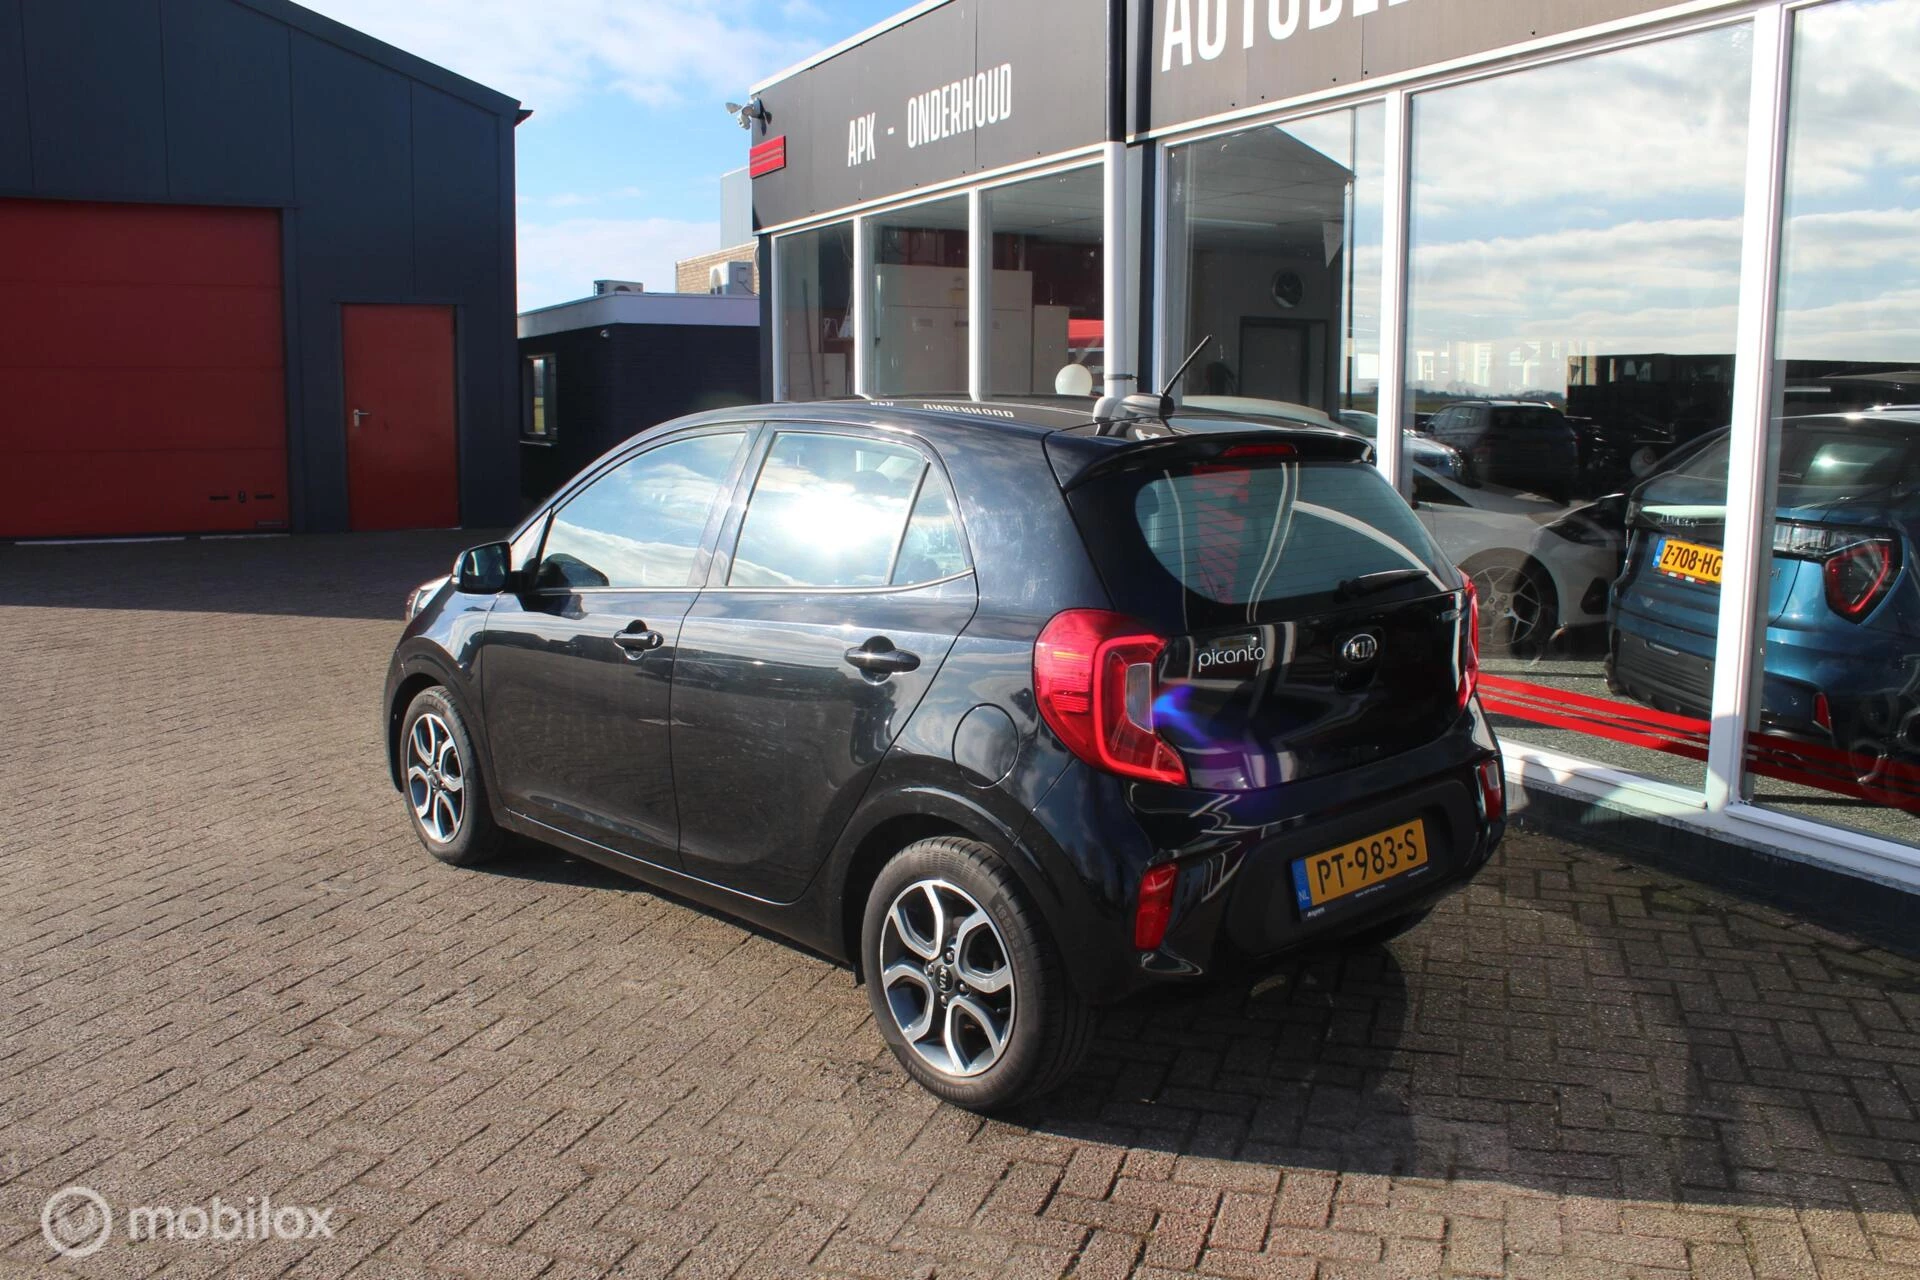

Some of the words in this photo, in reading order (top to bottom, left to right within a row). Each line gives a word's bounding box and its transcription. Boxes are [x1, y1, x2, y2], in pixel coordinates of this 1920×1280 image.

[847, 112, 876, 168] APK
[907, 63, 1012, 149] ONDERHOUD
[1662, 544, 1723, 577] Z-708-HG
[1198, 645, 1266, 673] picanto
[1316, 828, 1417, 895] PT-983-S
